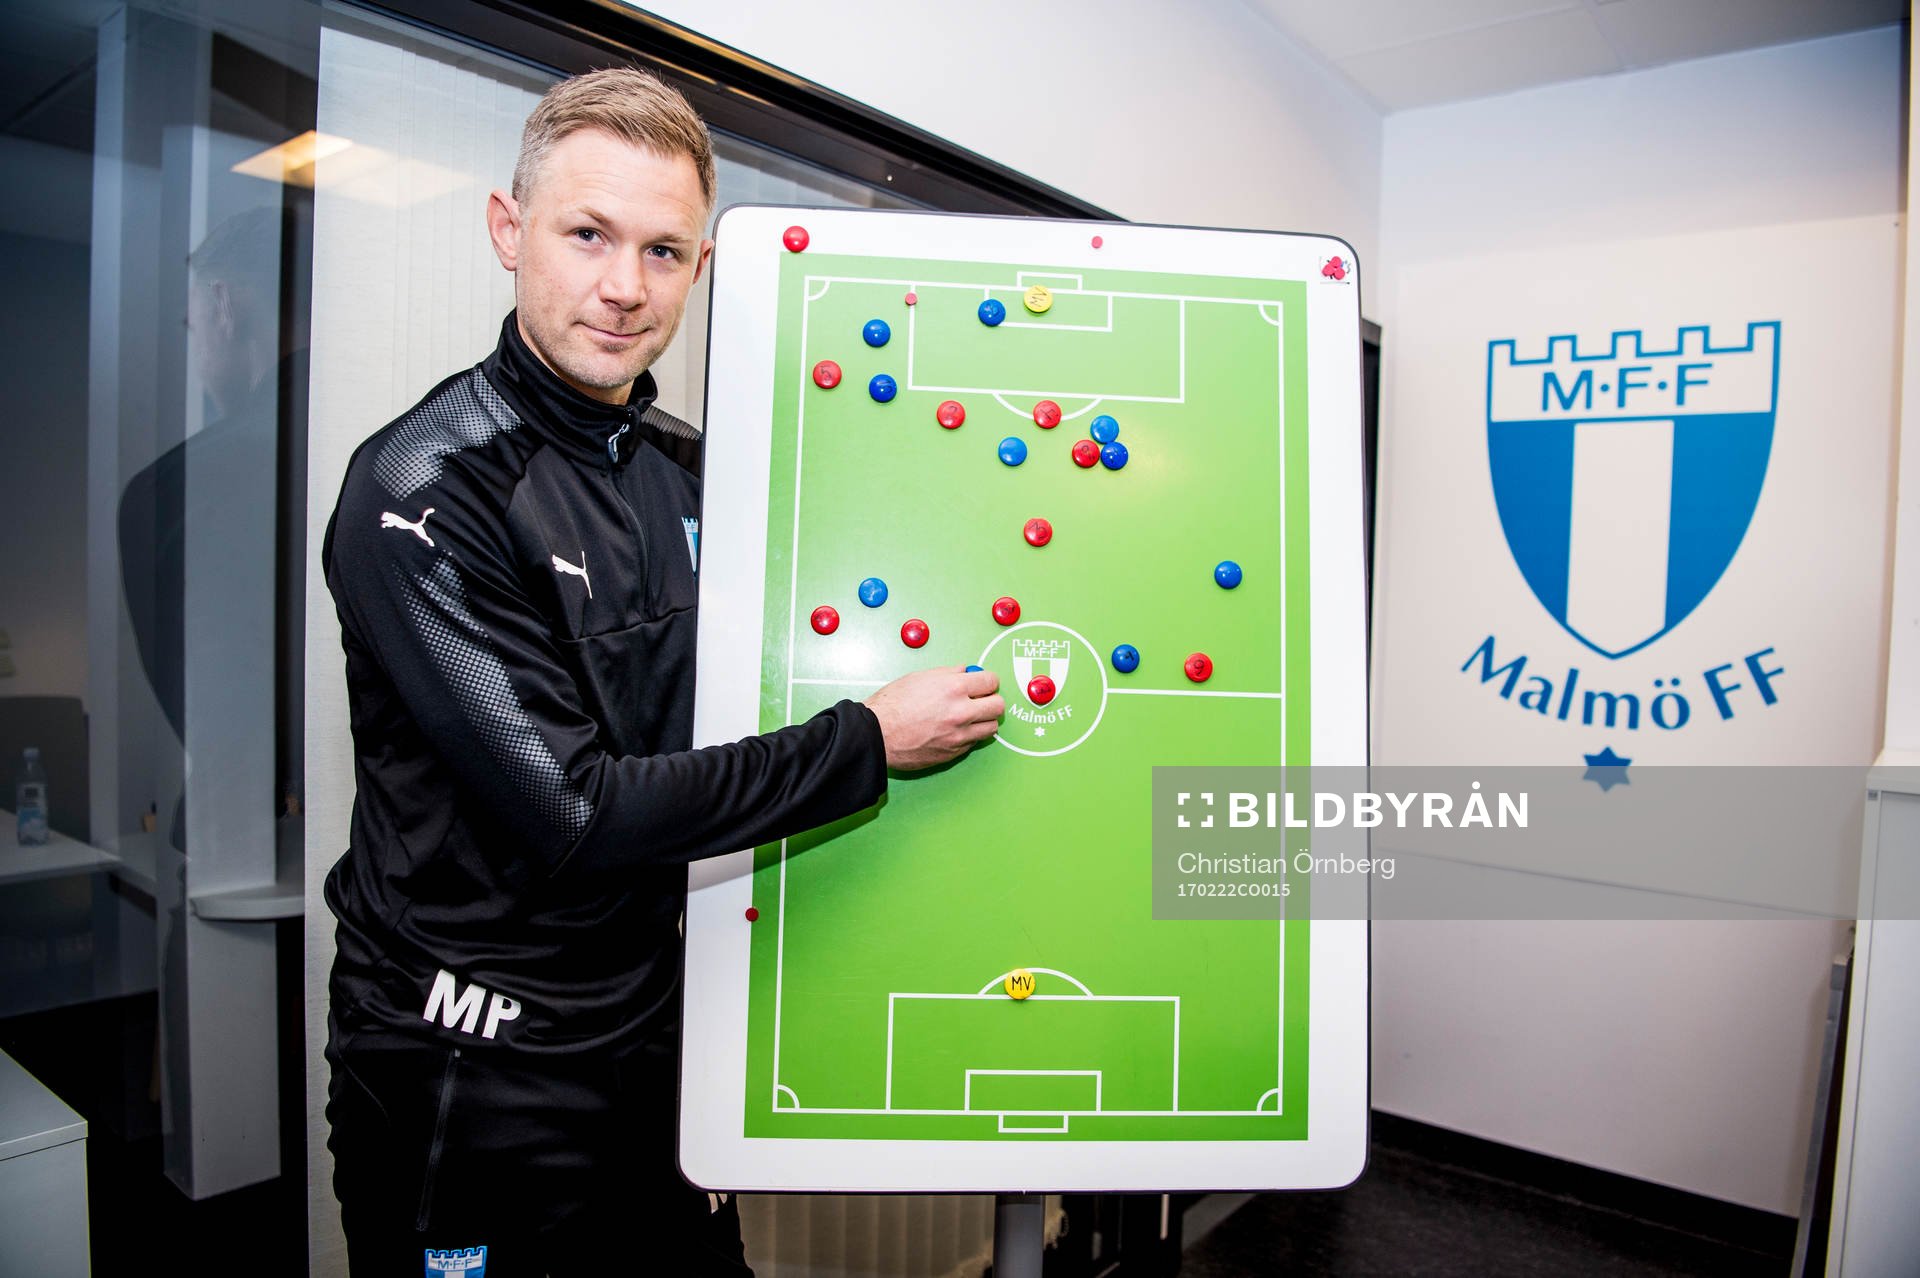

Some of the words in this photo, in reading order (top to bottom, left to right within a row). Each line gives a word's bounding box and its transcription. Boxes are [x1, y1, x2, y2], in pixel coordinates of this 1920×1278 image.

[1460, 635, 1690, 730] Malmö
[1703, 647, 1785, 721] FF
[1008, 703, 1056, 723] Malmö
[1057, 704, 1073, 721] FF
[423, 968, 522, 1040] MP
[1011, 976, 1032, 992] MV
